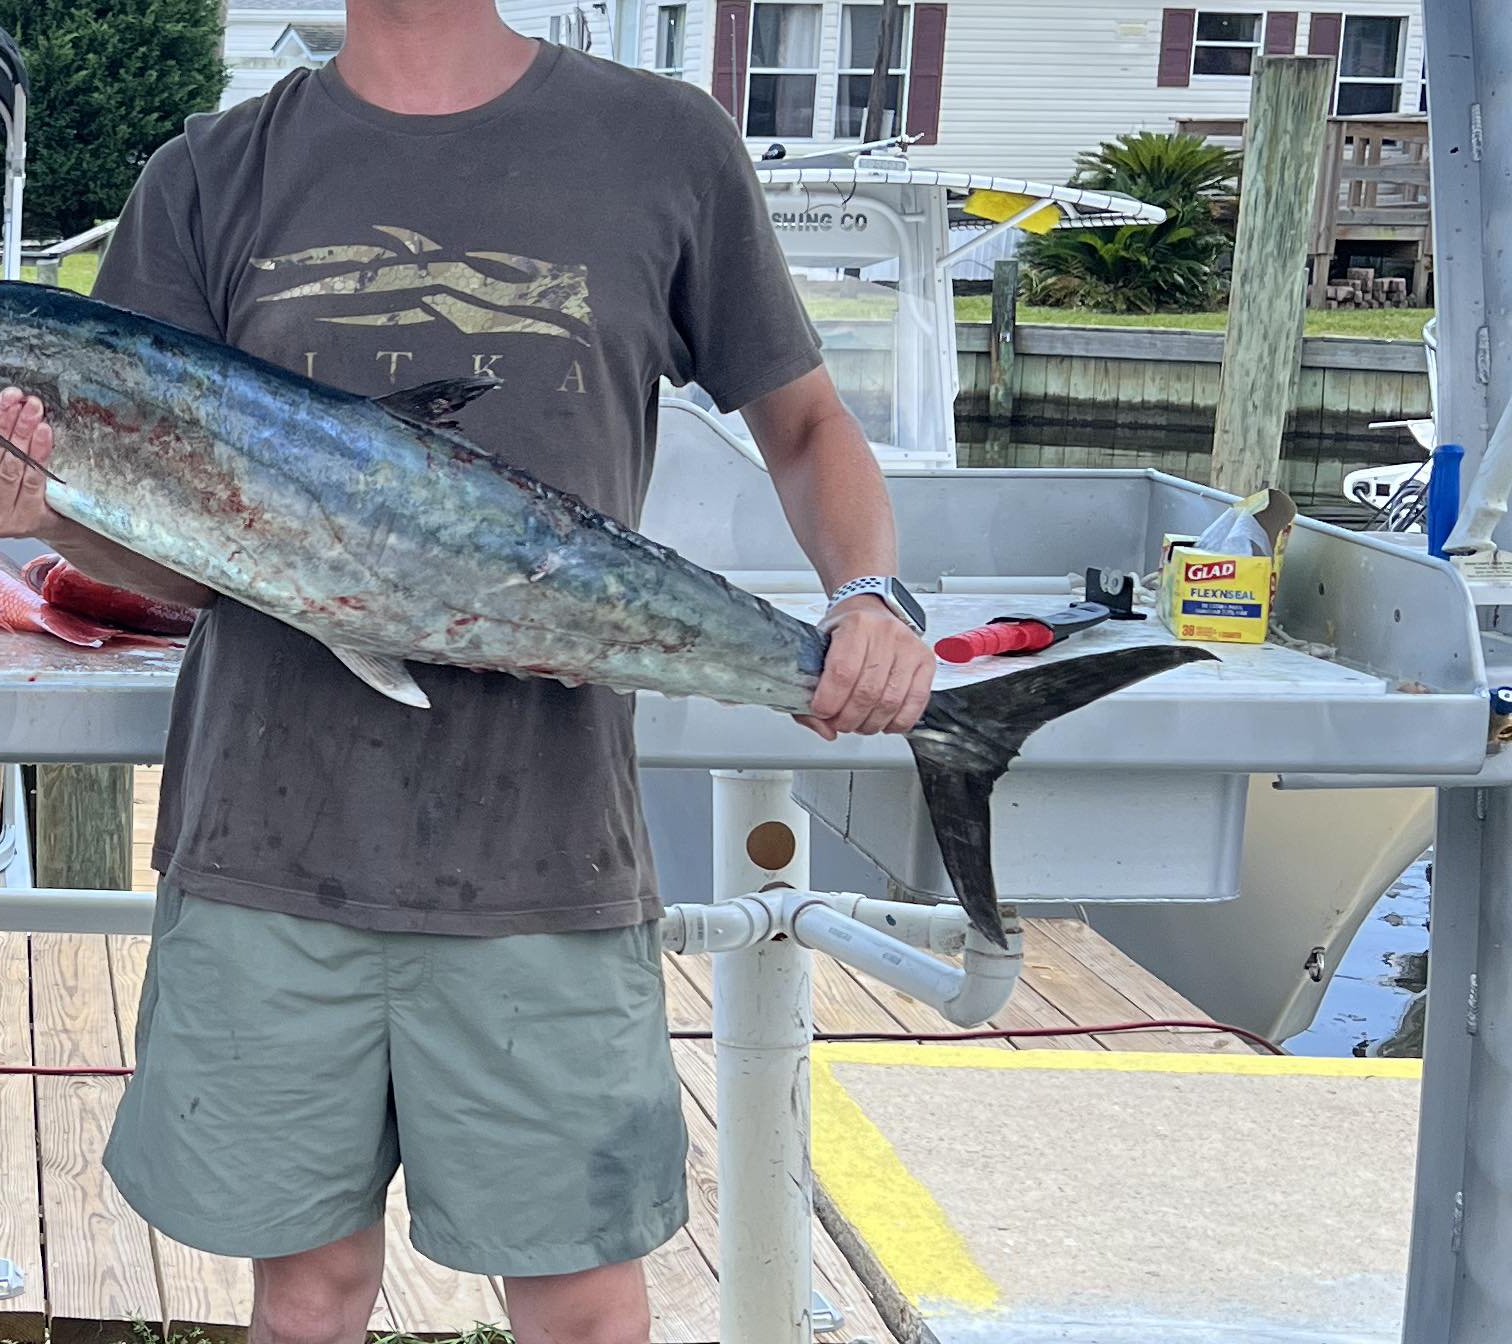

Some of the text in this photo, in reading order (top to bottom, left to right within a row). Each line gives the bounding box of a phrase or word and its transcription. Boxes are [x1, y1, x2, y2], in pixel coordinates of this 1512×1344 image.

[771, 212, 868, 232] SHING CO
[304, 351, 587, 394] ITKA
[1188, 562, 1235, 581] GLAD
